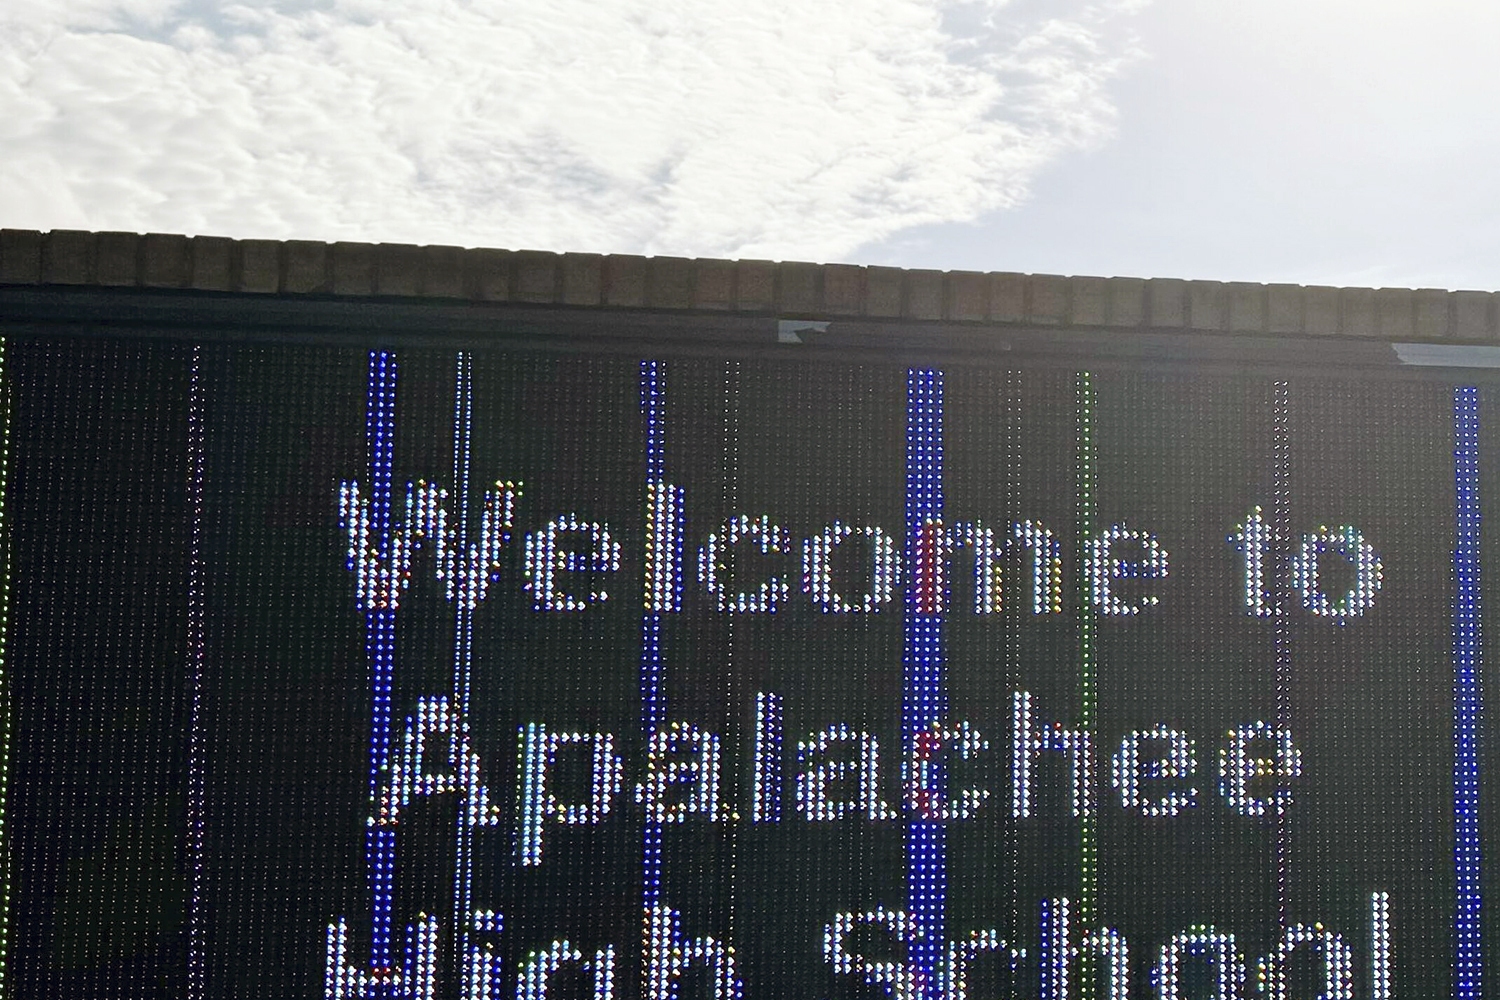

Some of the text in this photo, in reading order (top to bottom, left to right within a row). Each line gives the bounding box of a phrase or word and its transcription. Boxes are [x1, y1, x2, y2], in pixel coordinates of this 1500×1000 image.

[339, 480, 1383, 624] Welcome to
[366, 691, 1301, 866] Apalachee
